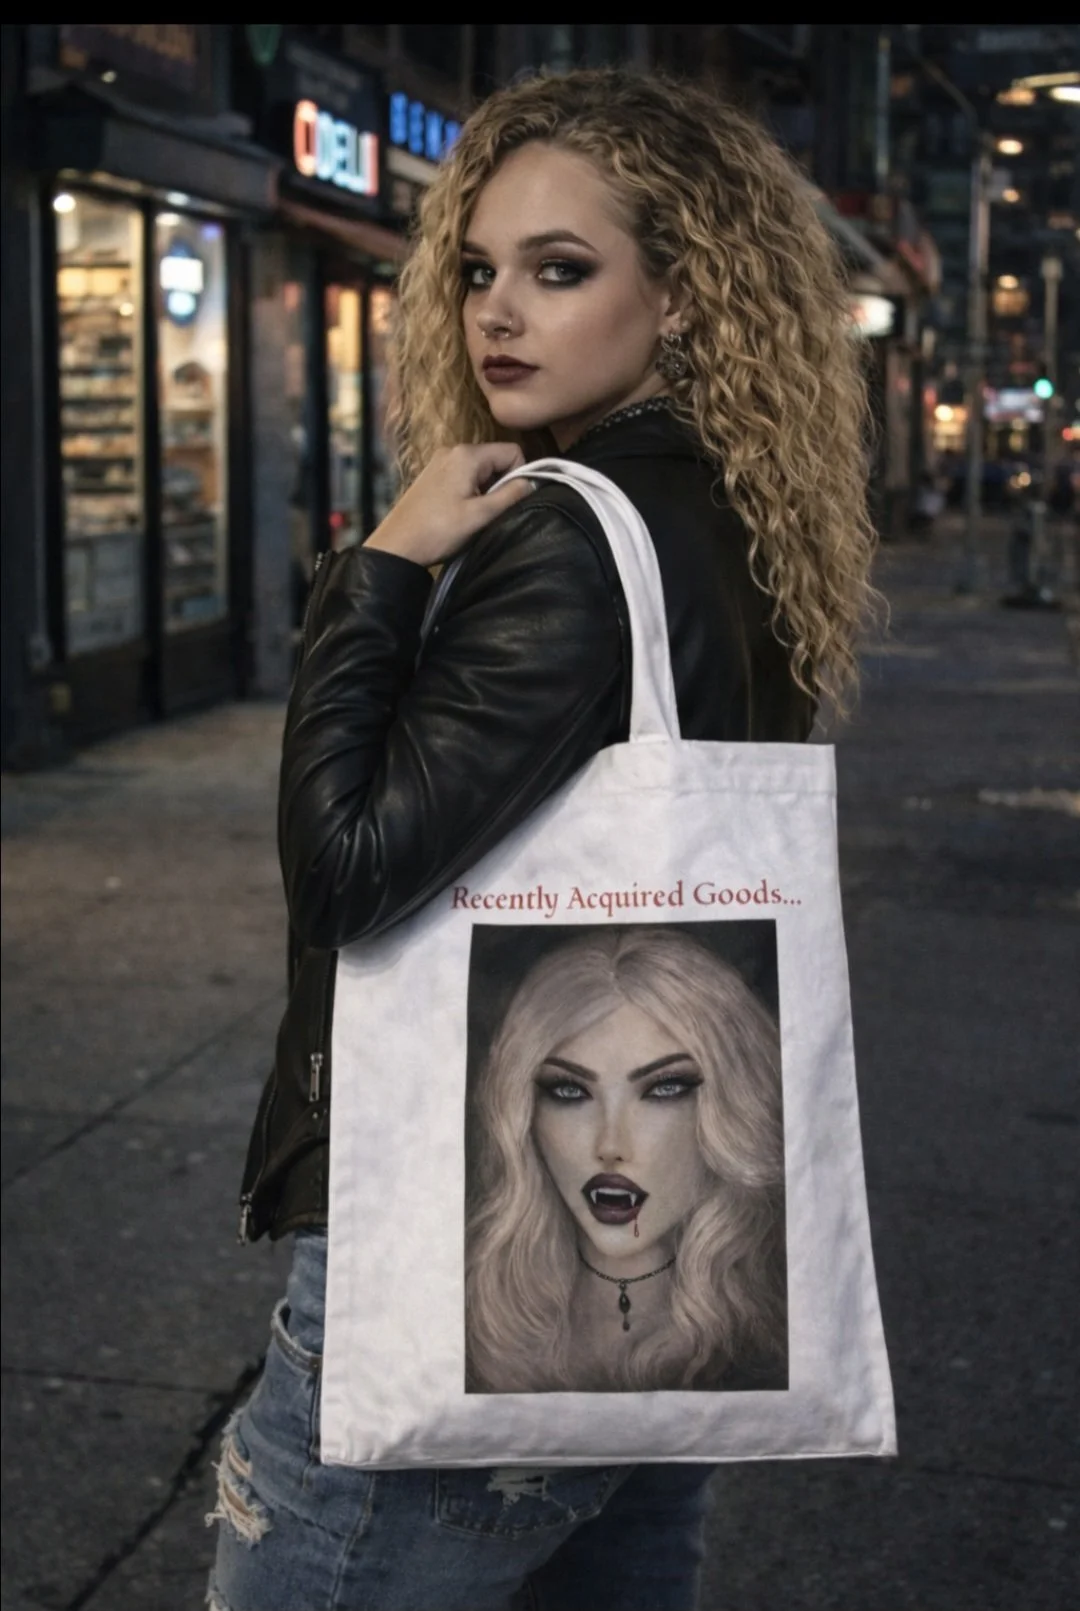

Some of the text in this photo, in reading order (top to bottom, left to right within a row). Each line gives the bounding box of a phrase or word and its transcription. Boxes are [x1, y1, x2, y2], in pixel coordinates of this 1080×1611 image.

[452, 879, 802, 918] Recently Acquired Goods...
